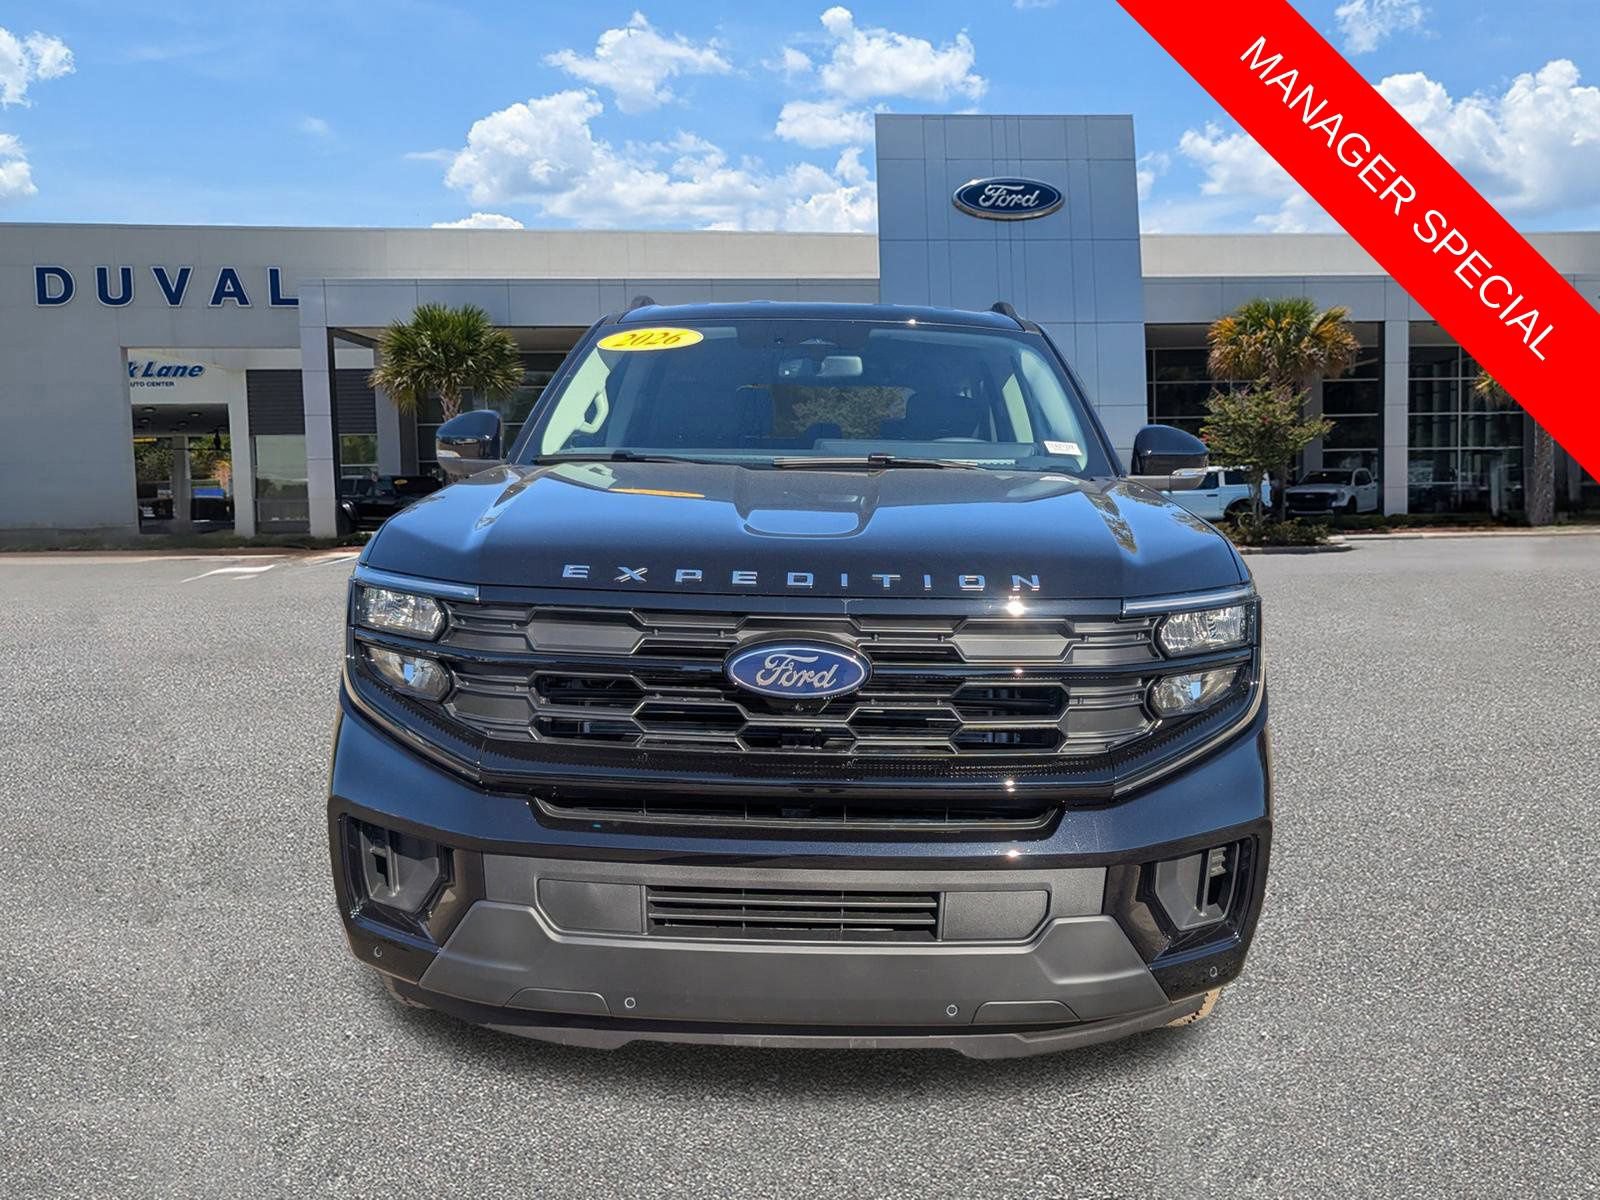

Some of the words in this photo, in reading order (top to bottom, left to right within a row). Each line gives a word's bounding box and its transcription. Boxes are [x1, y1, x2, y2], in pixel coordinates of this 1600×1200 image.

[978, 183, 1040, 208] Ford
[33, 265, 299, 308] DUVAL
[612, 331, 684, 347] 2026
[141, 361, 205, 378] Lane
[561, 563, 1041, 593] EXPEDITION
[755, 653, 839, 690] Ford
